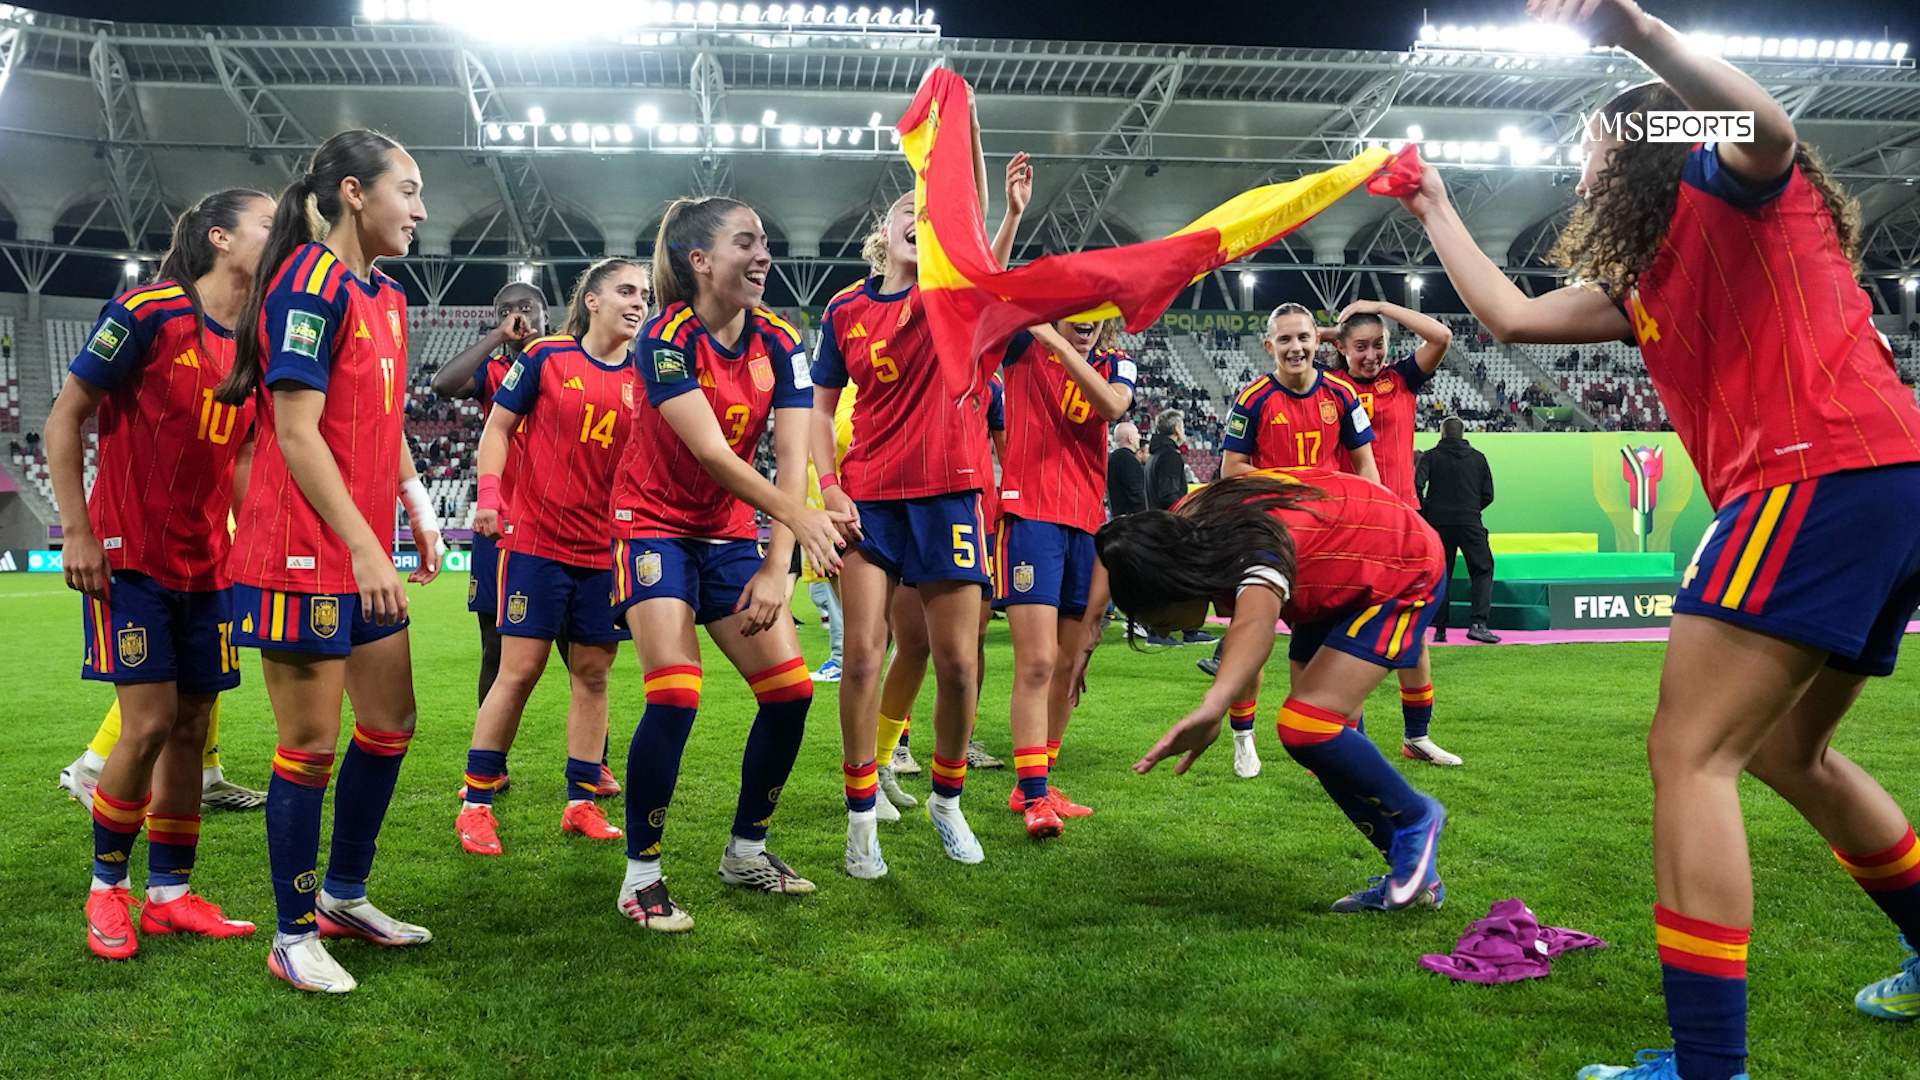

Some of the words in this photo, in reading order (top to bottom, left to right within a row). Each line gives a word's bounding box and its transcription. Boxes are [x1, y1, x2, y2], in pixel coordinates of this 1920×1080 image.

[1164, 313, 1244, 330] POLAND
[870, 339, 899, 383] 5
[198, 387, 238, 445] 10
[580, 403, 617, 449] 14
[725, 404, 750, 446] 3
[1295, 430, 1321, 465] 17
[952, 524, 975, 568] 5
[1574, 595, 1630, 618] FIFA
[1634, 594, 1676, 617] U2
